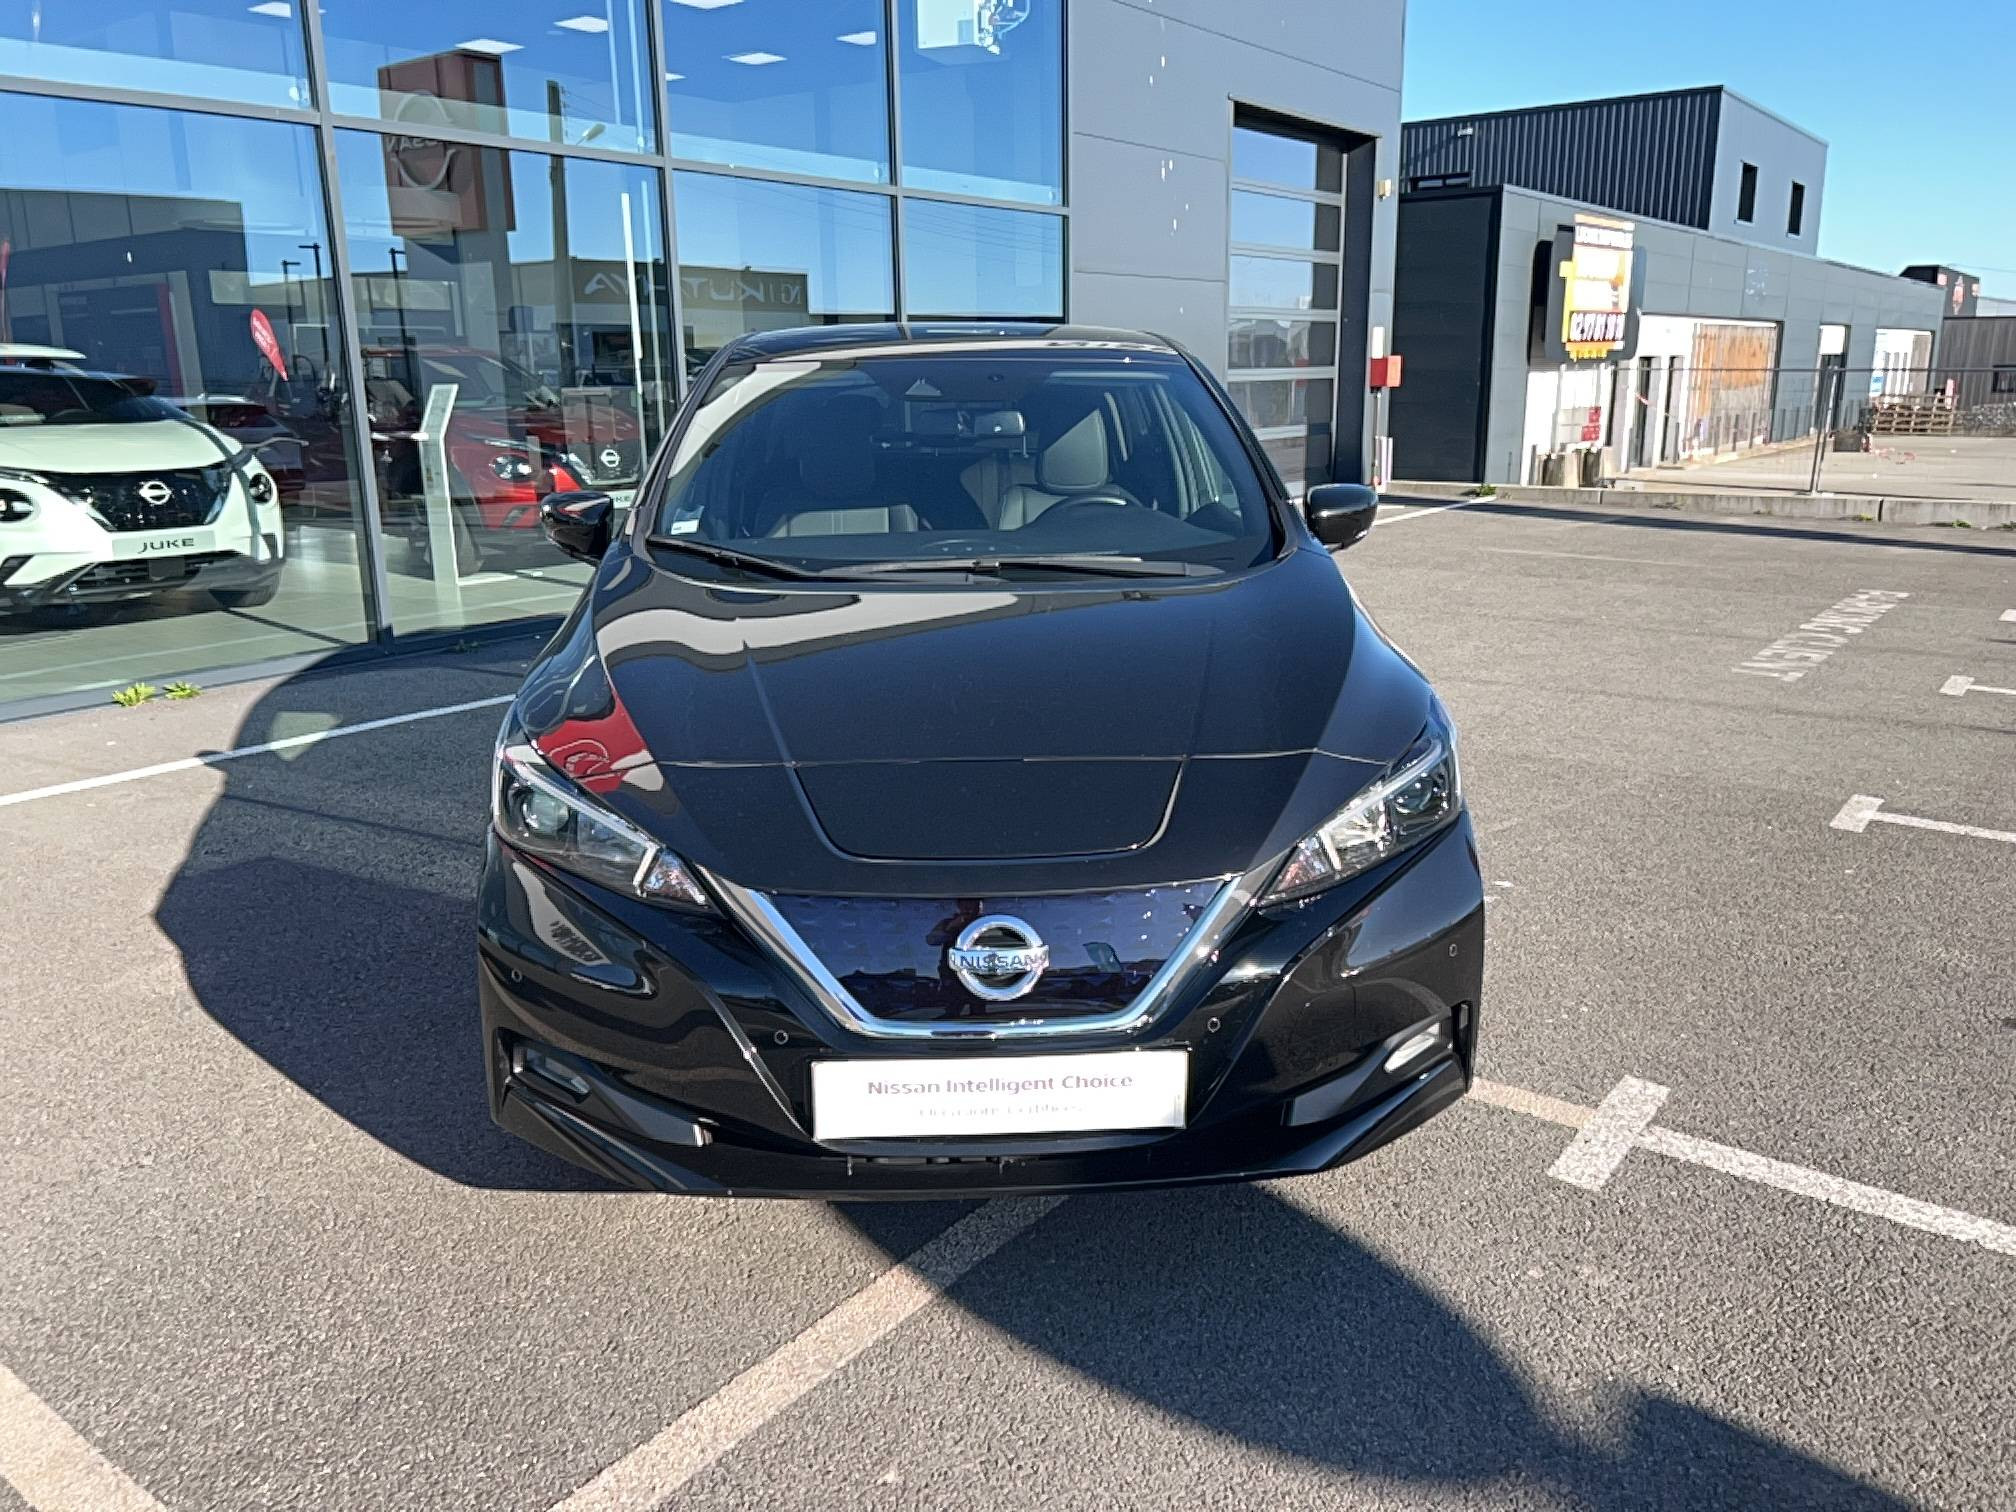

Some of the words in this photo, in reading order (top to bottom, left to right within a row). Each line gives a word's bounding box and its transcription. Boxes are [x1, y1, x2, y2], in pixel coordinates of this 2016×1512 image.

[137, 537, 195, 554] JUKE
[1731, 632, 1849, 682] CLIENT
[959, 953, 1042, 969] NISSAN
[868, 1081, 940, 1095] Nissan
[946, 1076, 1054, 1095] Intelligent
[1061, 1074, 1133, 1090] Choice
